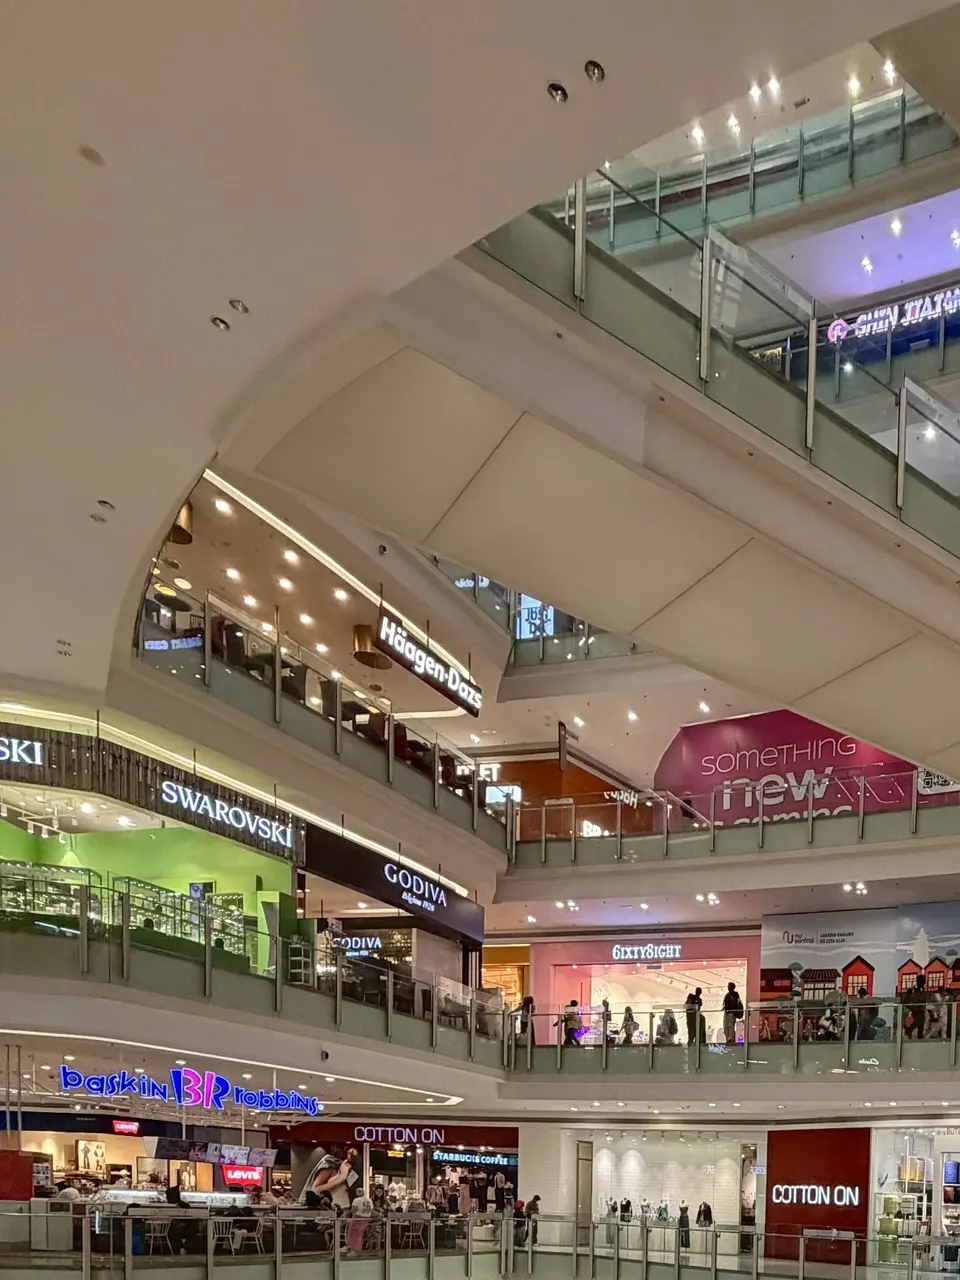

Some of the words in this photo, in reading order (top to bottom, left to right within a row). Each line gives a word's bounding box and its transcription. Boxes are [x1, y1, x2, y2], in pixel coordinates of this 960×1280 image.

[161, 780, 293, 848] SWAROVSKI
[384, 863, 447, 908] GODIVA
[612, 944, 681, 960] 6IXTY8IGHT
[58, 1065, 169, 1103] baskin
[233, 1086, 319, 1116] robbins
[354, 1126, 417, 1143] COTTON
[421, 1128, 445, 1144] ON
[433, 1151, 480, 1164] STARBUCKS
[480, 1155, 508, 1166] COFFEE
[771, 1183, 833, 1206] COTTON
[836, 1184, 860, 1207] ON
